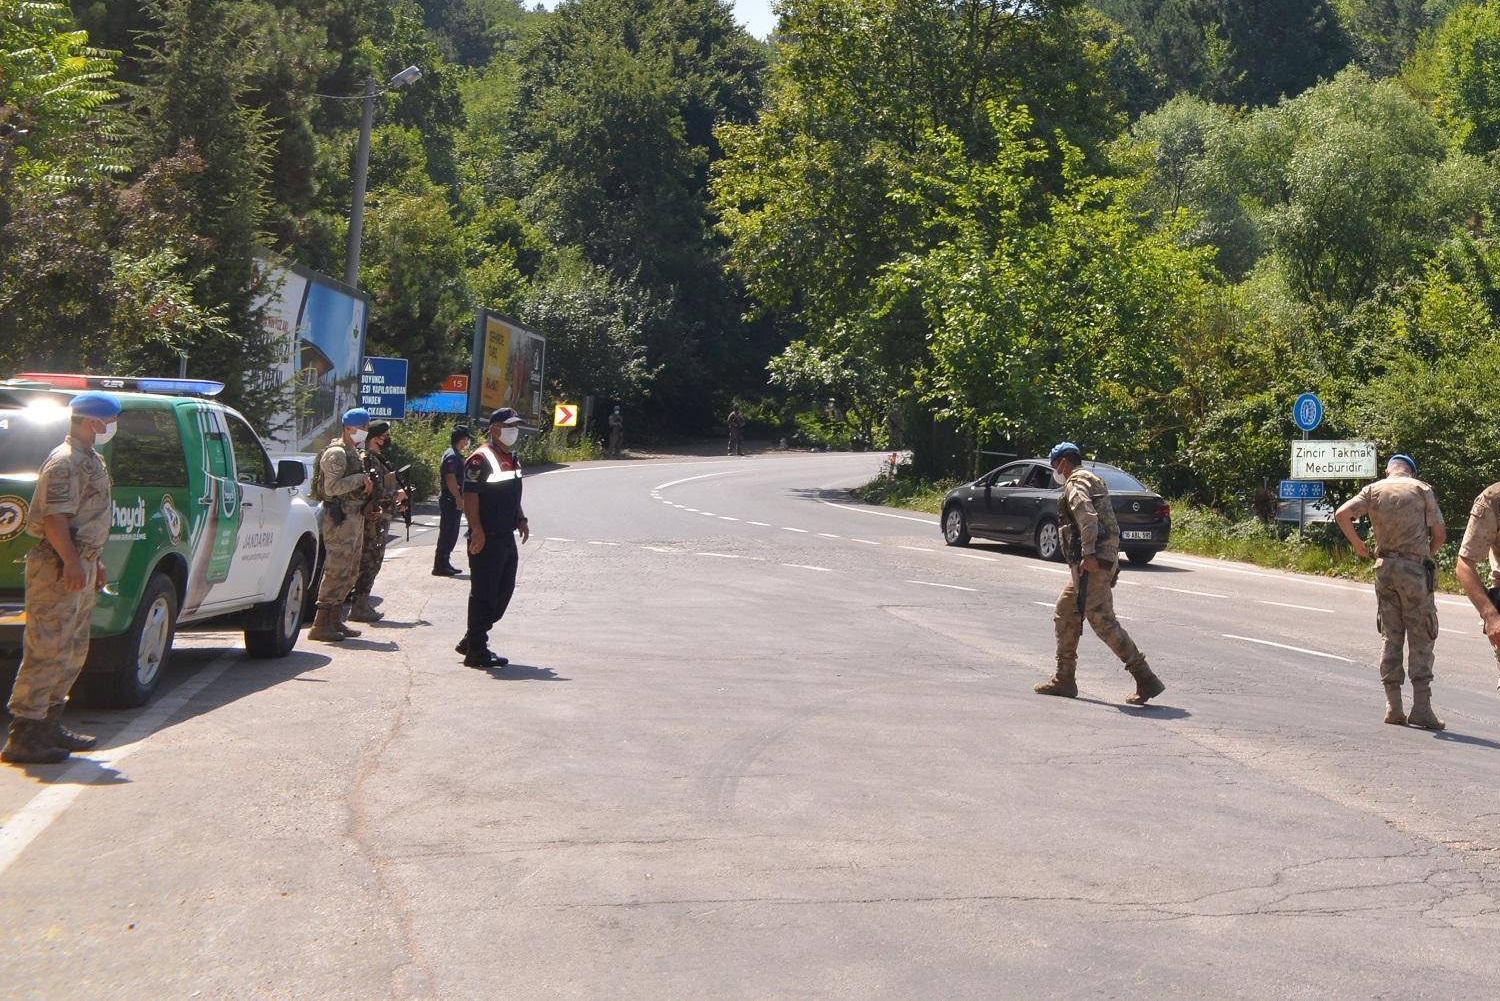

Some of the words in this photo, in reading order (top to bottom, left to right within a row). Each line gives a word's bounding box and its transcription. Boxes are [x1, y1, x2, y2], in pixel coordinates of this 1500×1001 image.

[452, 380, 463, 388] 15
[1296, 447, 1325, 458] Zincir
[1331, 446, 1372, 458] Takmak
[1306, 462, 1362, 472] Mecburidir
[242, 531, 274, 549] JANDARMA
